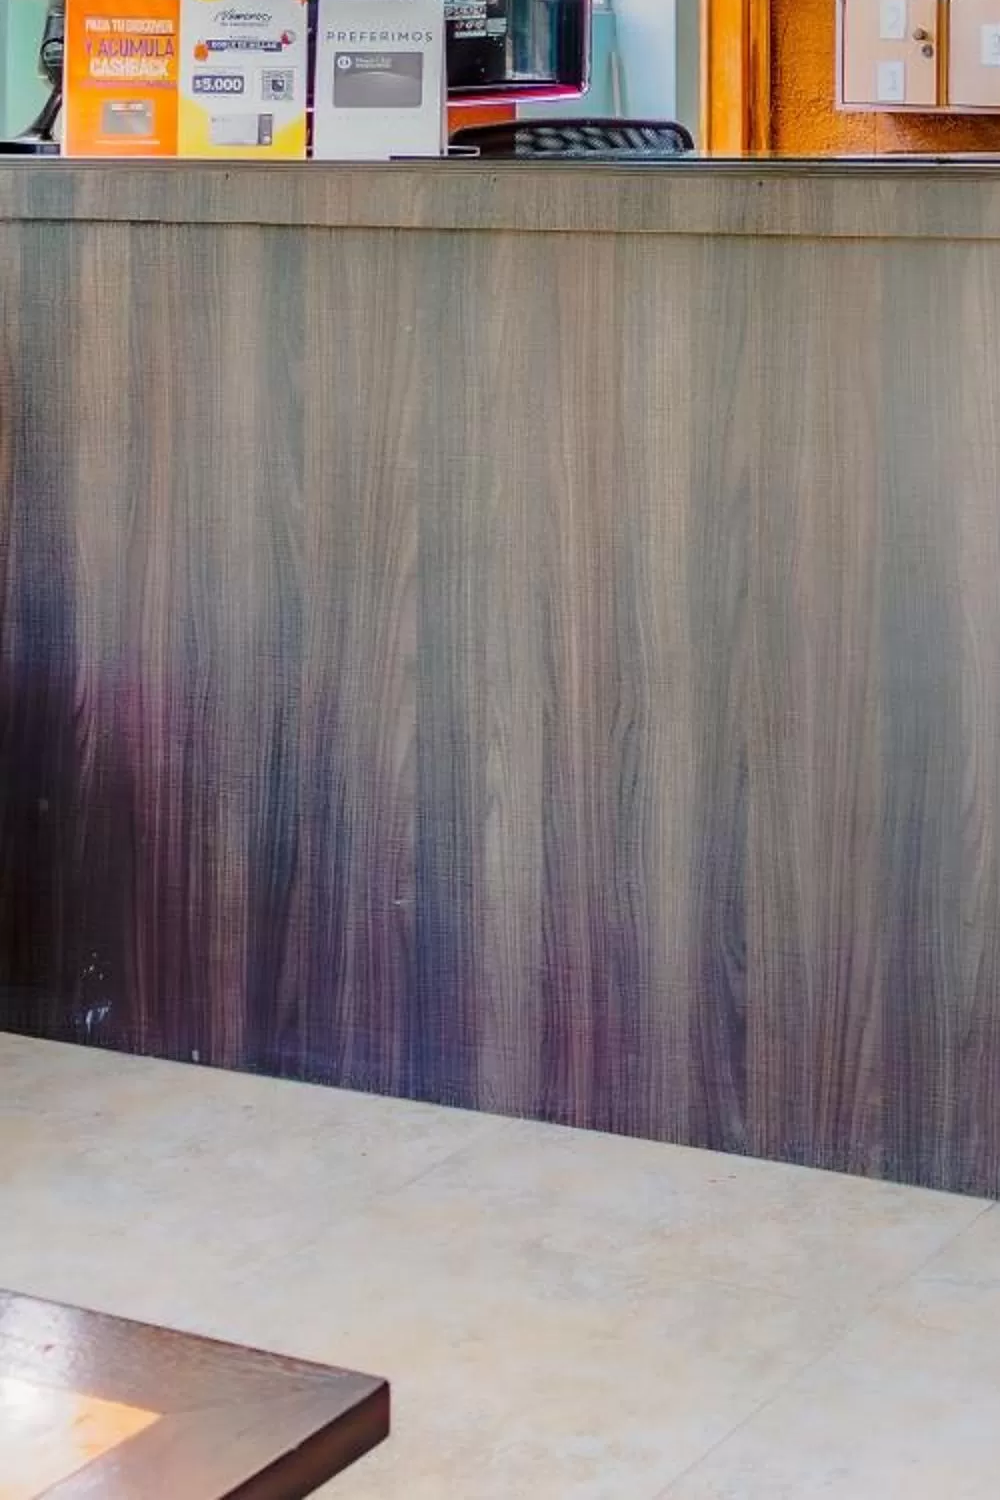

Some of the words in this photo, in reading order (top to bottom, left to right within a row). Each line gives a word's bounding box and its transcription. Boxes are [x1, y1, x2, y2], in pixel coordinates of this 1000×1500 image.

[325, 31, 434, 43] PREFERIMOS
[97, 37, 175, 57] ACUMULA
[89, 57, 170, 77] CASHBACK
[194, 77, 243, 92] $5.000
